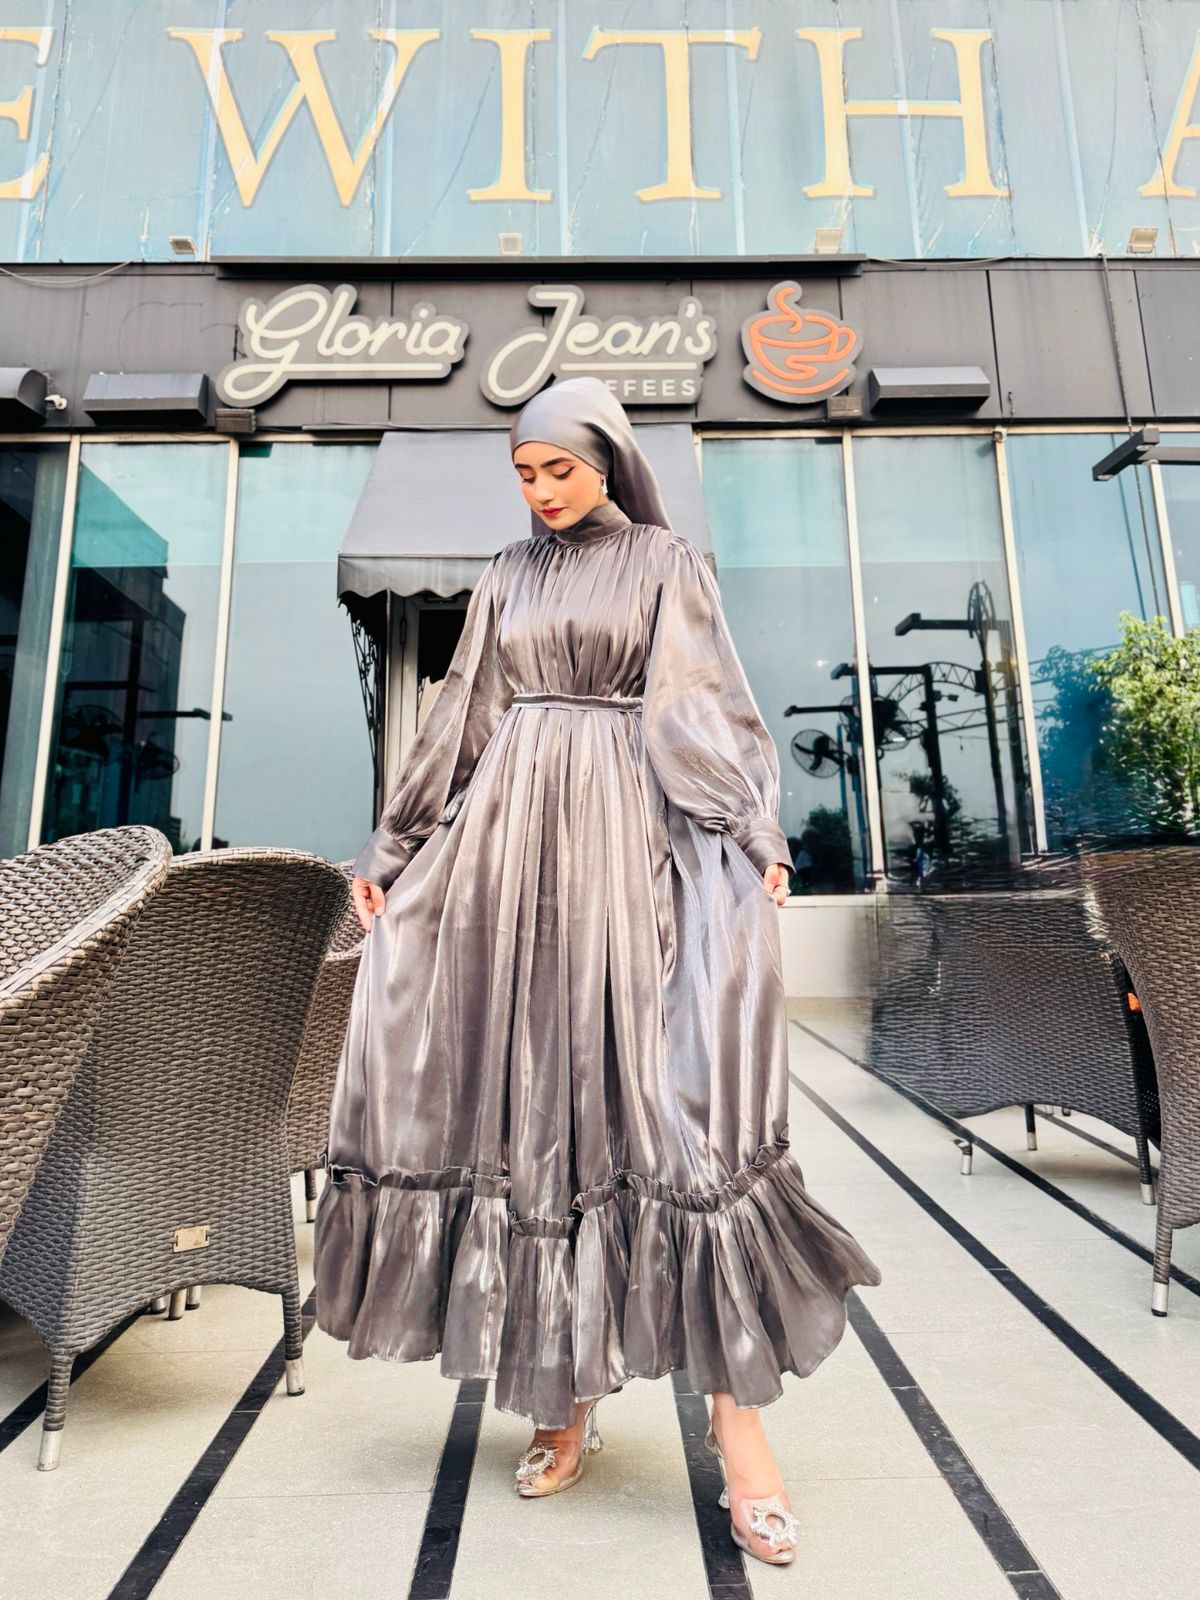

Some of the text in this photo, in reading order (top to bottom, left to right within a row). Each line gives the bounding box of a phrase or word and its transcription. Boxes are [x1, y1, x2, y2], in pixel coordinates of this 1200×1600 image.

[167, 27, 1011, 207] WITH
[223, 290, 711, 400] Gloria Jean's
[604, 379, 697, 397] FFEES
